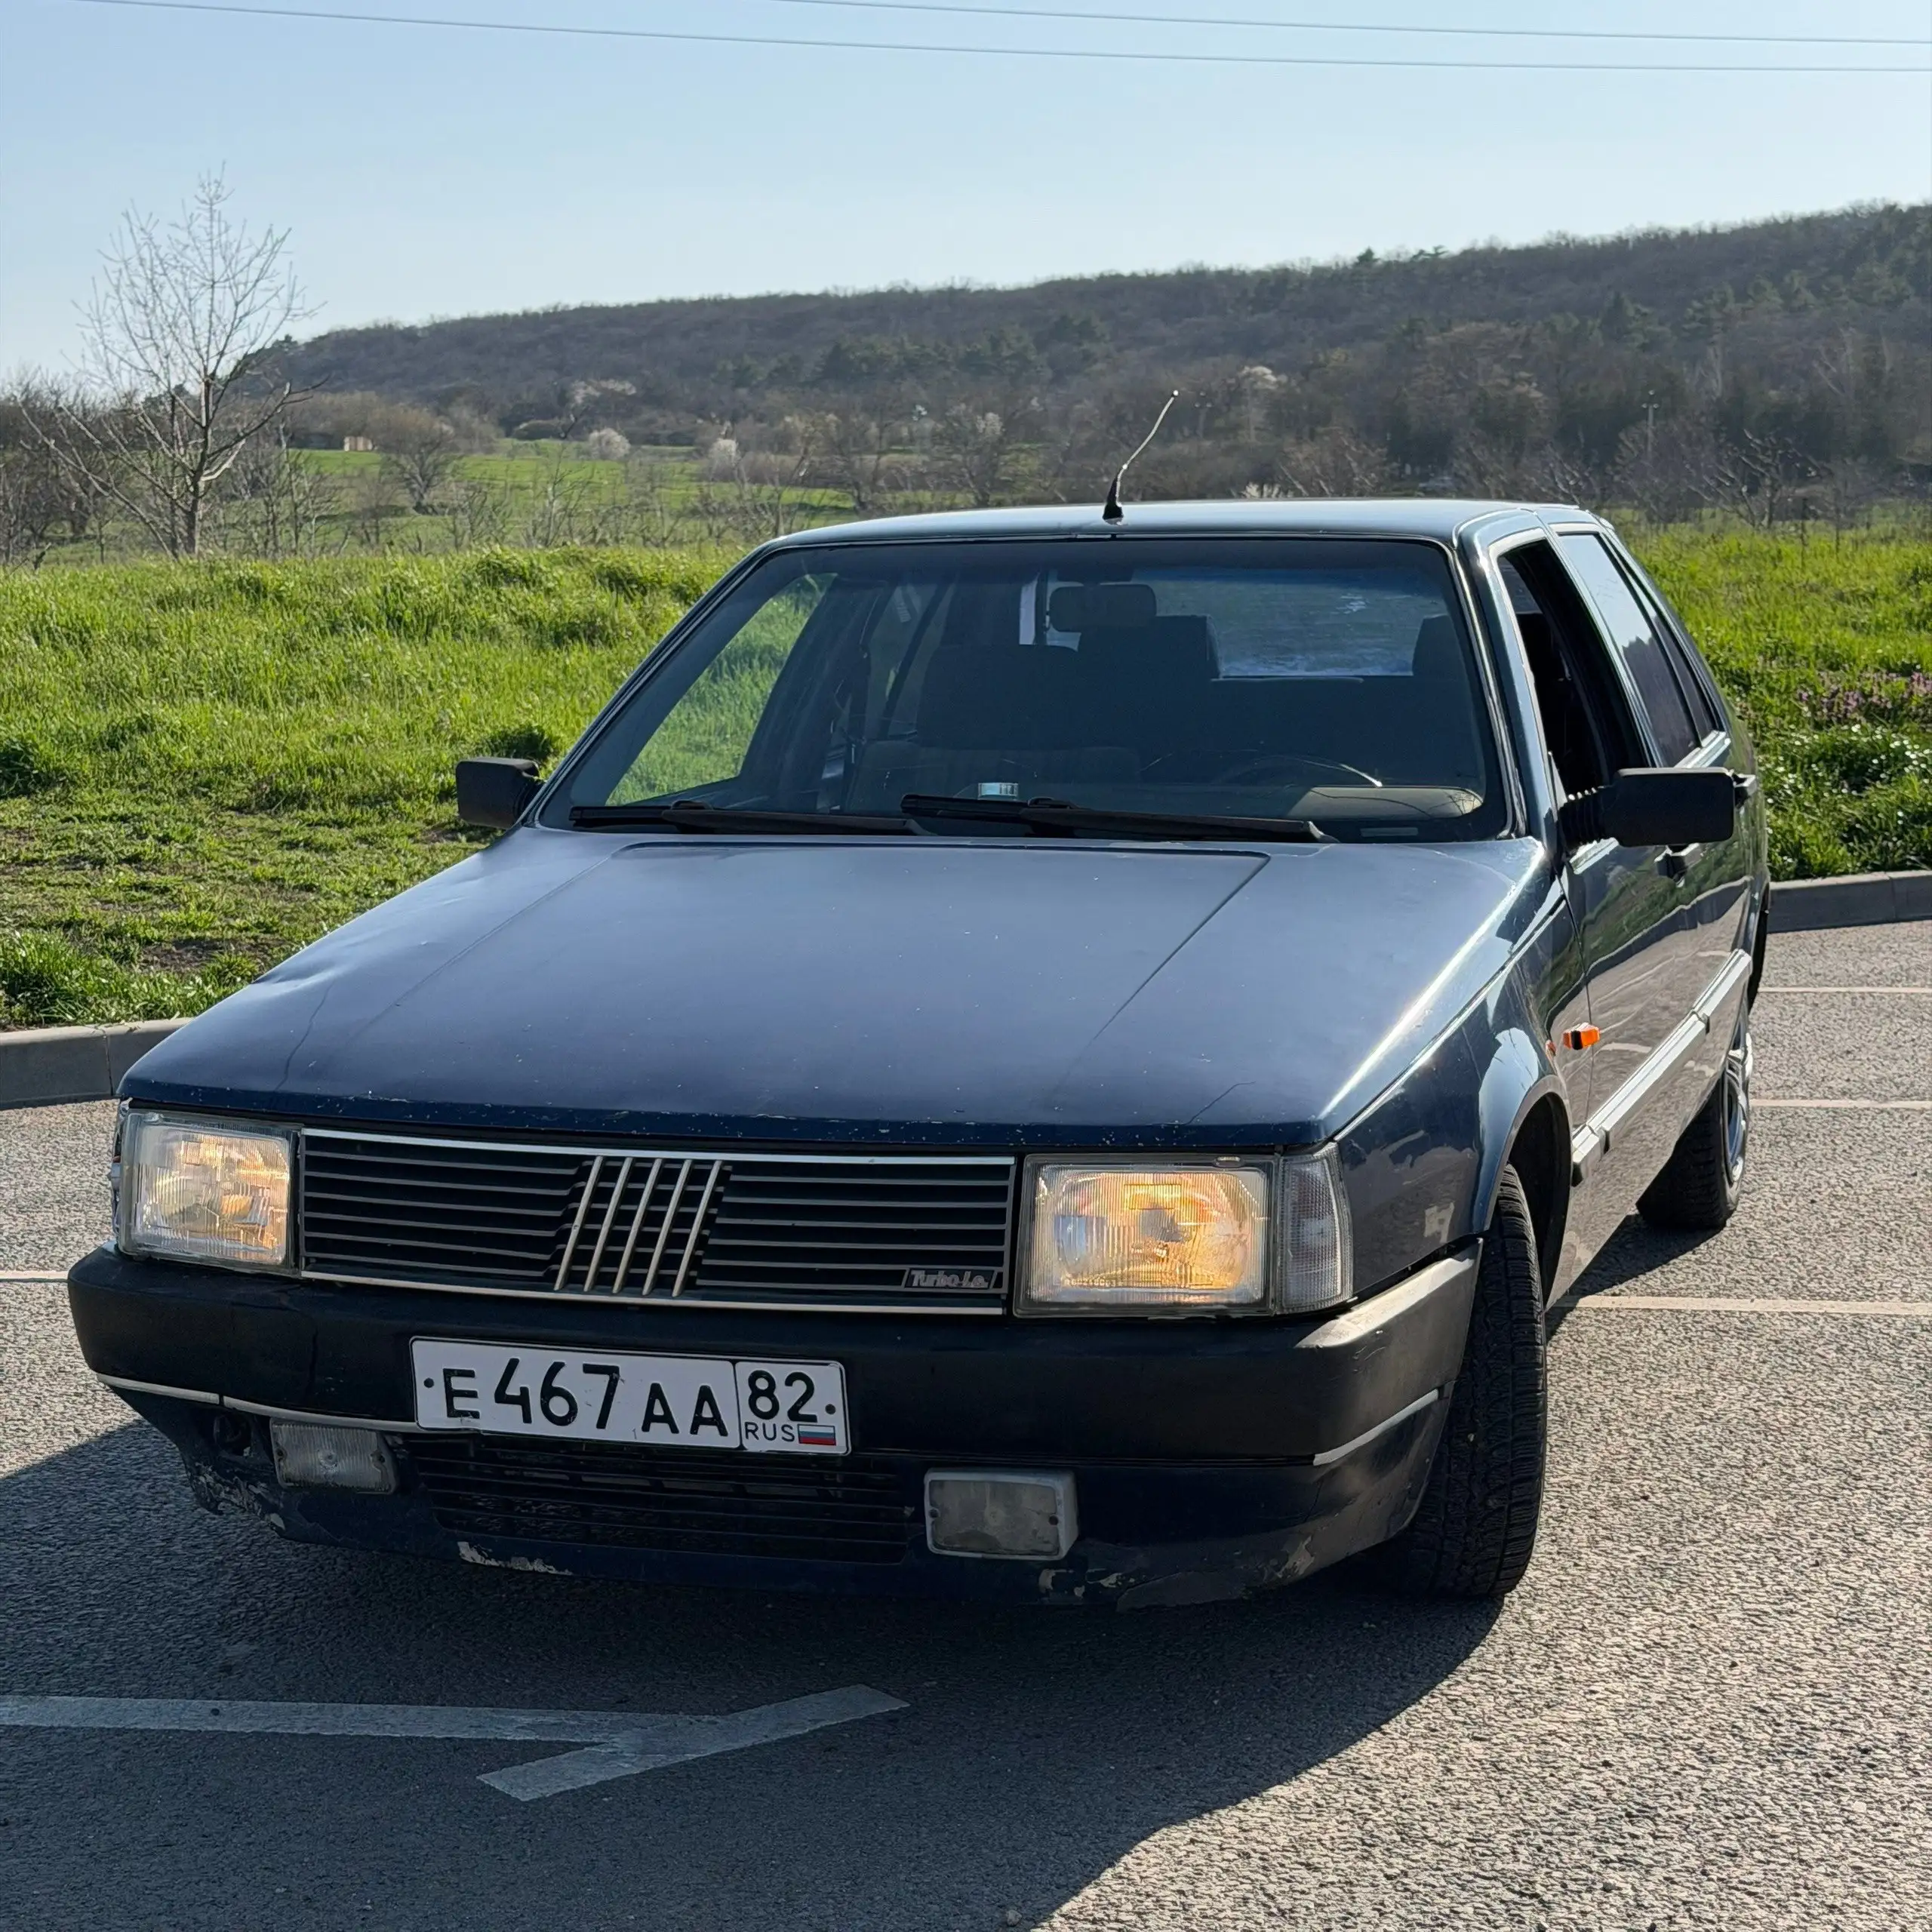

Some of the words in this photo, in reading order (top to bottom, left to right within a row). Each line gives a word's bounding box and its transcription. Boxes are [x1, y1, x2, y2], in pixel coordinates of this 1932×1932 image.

[911, 1269, 960, 1287] Turbo
[748, 1370, 817, 1423] 82
[745, 1422, 795, 1442] RUS
